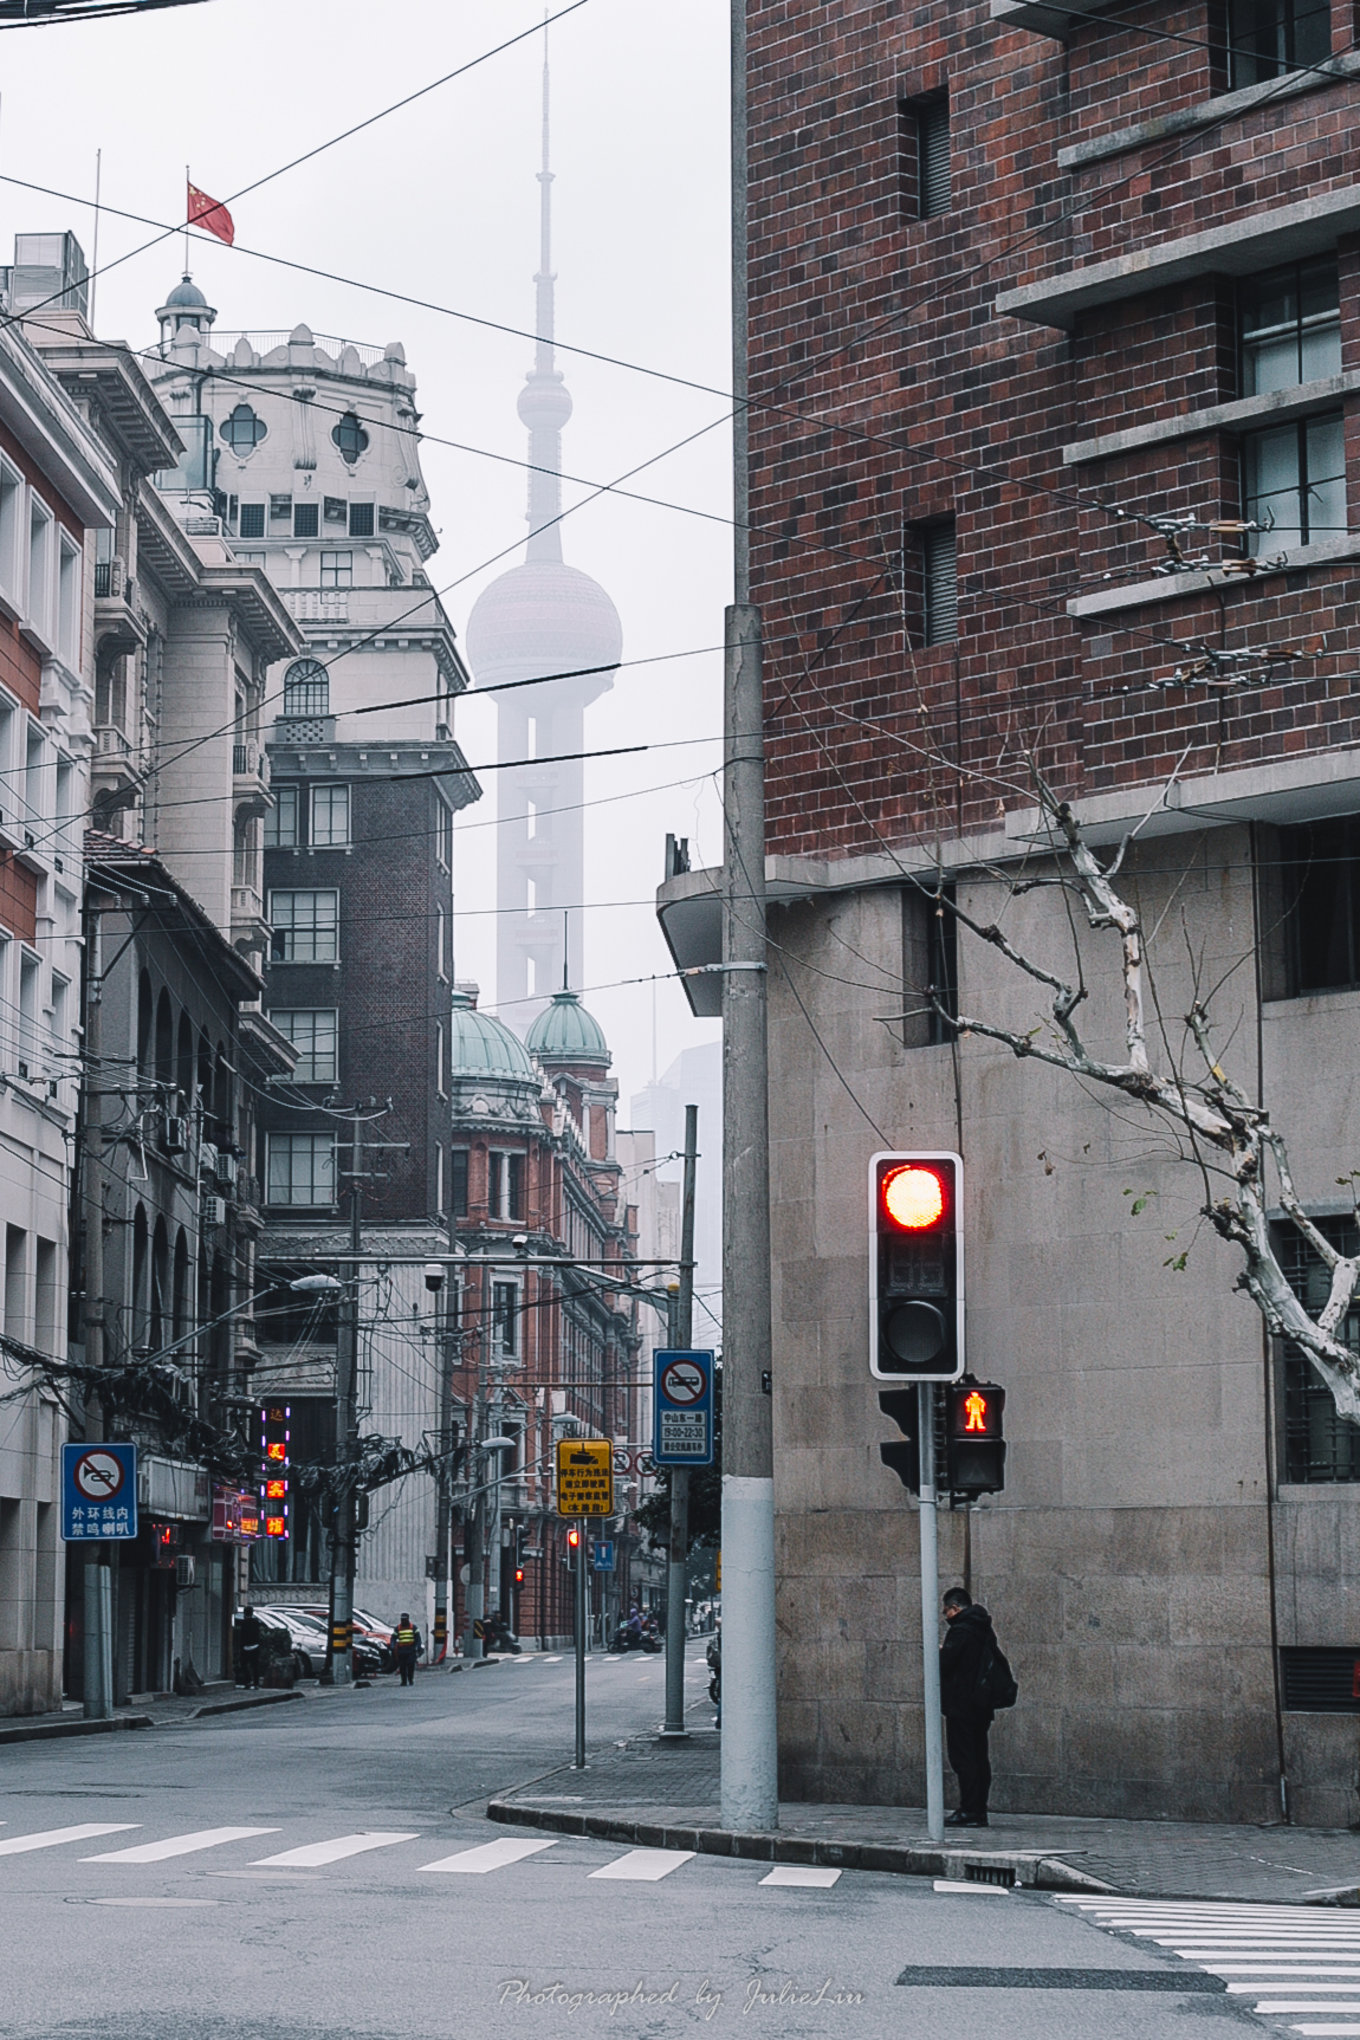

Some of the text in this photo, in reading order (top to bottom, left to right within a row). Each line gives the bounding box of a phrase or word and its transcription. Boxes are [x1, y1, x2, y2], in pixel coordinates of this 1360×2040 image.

[664, 1413, 703, 1423] 中山东一路
[72, 1506, 129, 1520] 外环线内
[72, 1522, 130, 1536] 禁鸣喇叭
